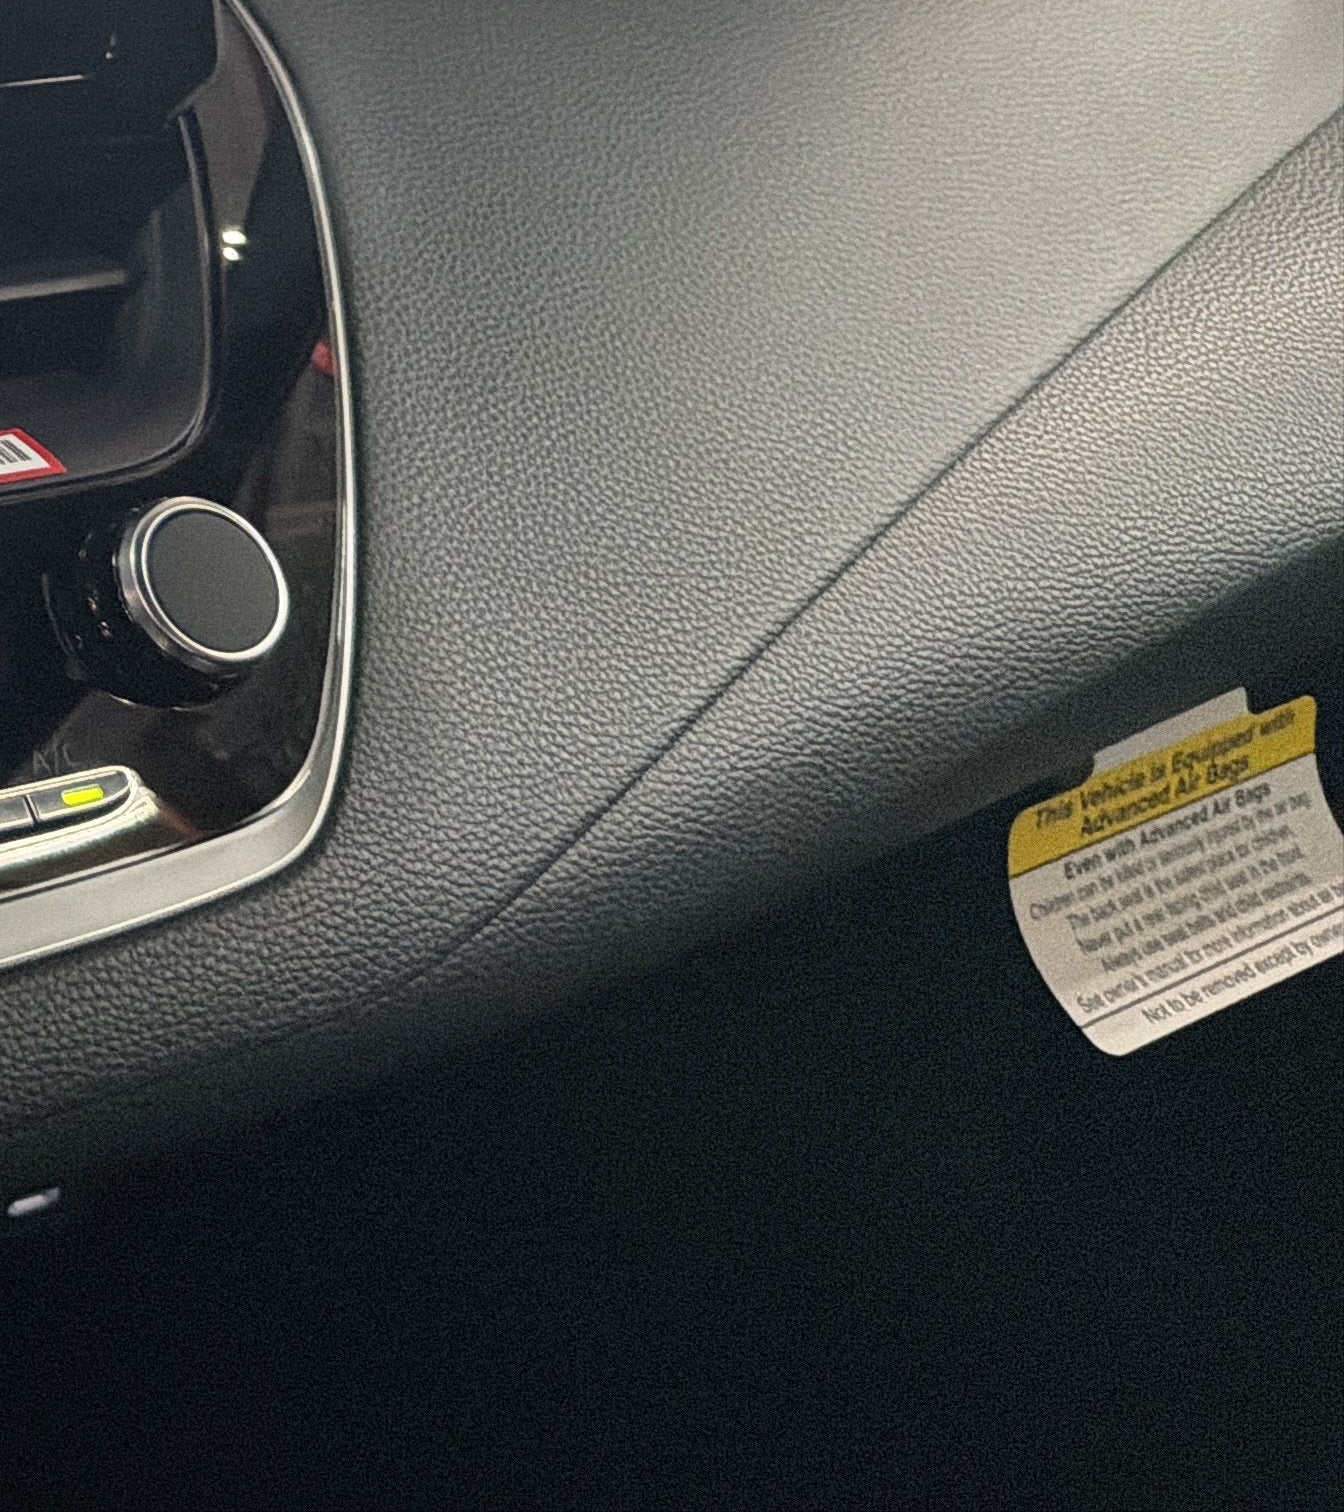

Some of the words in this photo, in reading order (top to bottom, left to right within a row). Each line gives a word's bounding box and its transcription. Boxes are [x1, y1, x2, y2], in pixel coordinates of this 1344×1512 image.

[1064, 853, 1102, 880] Even
[1103, 837, 1136, 862] with
[1140, 804, 1209, 848] Advanced
[1212, 797, 1231, 817] Air
[1234, 783, 1272, 808] Bags
[1076, 992, 1105, 1013] See
[1141, 1003, 1173, 1024] Not
[1167, 998, 1186, 1013] to
[1181, 990, 1204, 1008] be
[1200, 962, 1257, 998] removed
[1254, 945, 1297, 975] except
[1290, 940, 1313, 958] by
